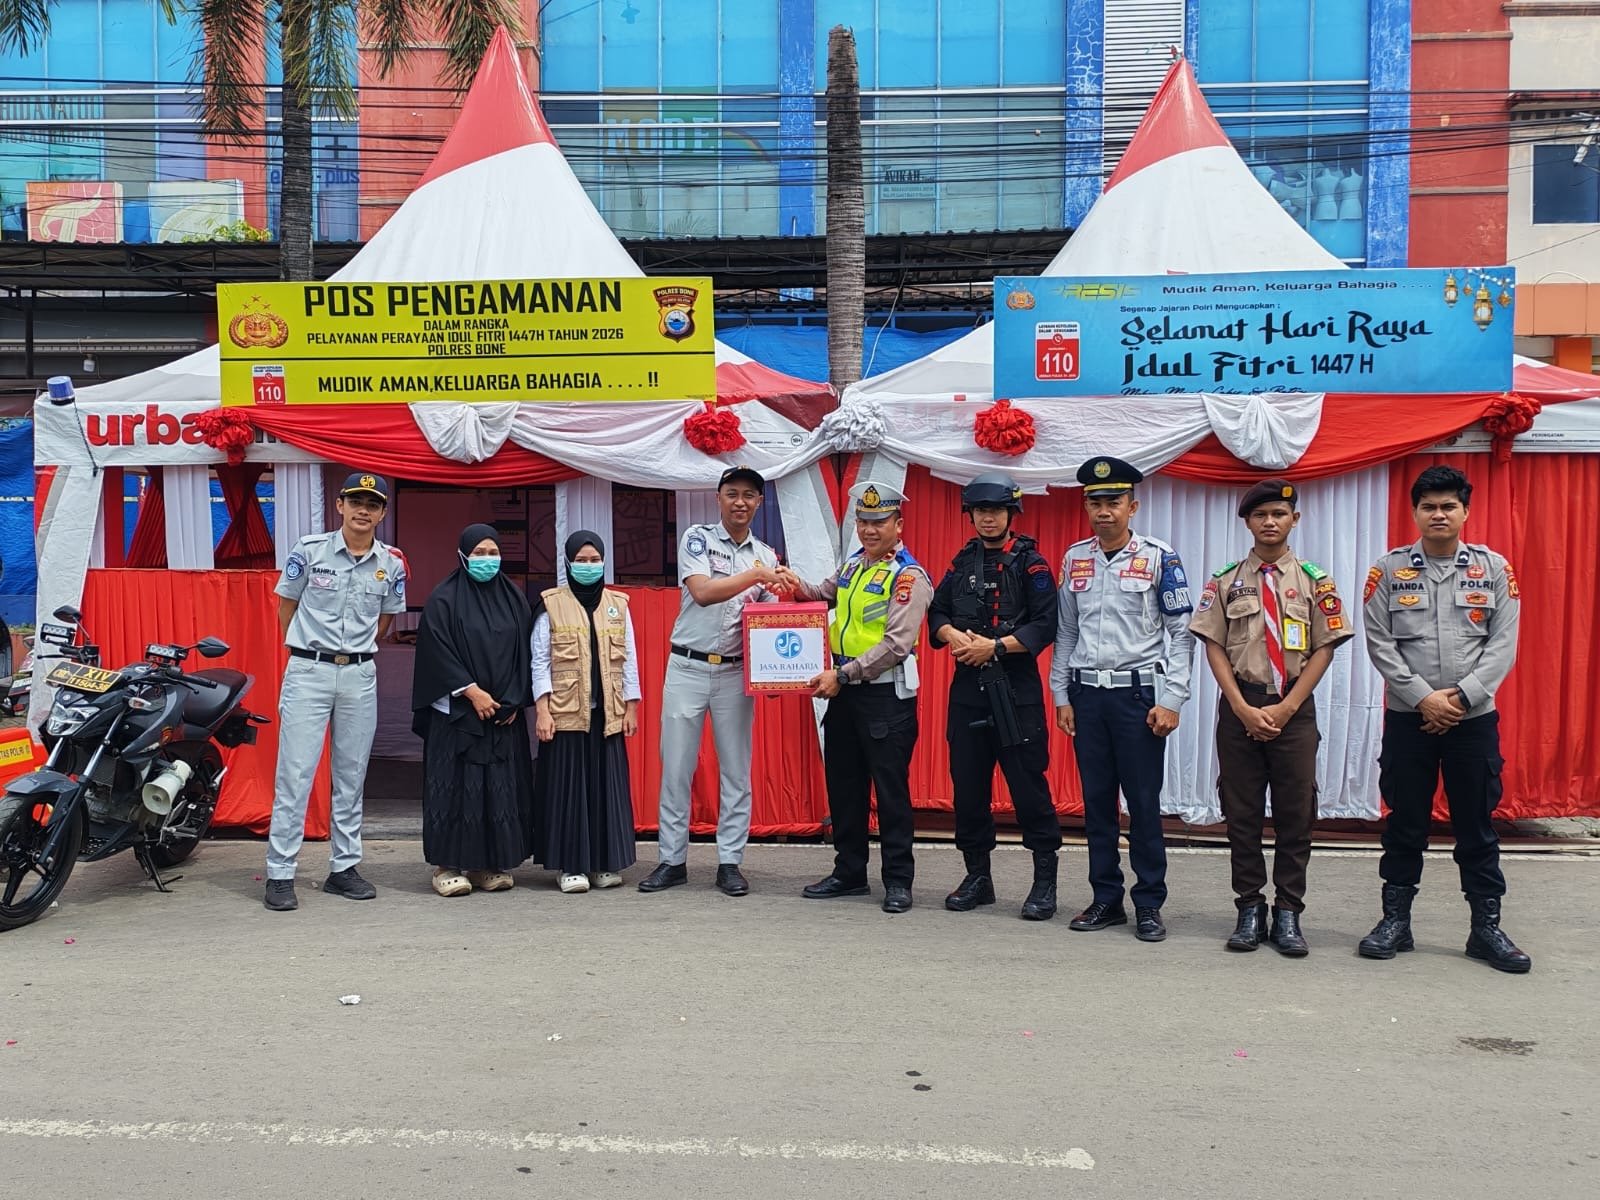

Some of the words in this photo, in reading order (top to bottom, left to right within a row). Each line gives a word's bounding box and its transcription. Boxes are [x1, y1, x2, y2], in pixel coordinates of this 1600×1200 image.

[1162, 285, 1207, 294] Mudik
[1212, 284, 1260, 293] Aman,
[1265, 282, 1332, 291] Keluarga
[1338, 281, 1397, 290] Bahagia
[304, 286, 374, 316] POS
[387, 281, 622, 316] PENGAMANAN
[1120, 305, 1156, 313] Segenap
[1159, 304, 1190, 312] Jajaran
[1193, 303, 1212, 311] Polri
[1215, 302, 1275, 311] Mengucapkan
[424, 319, 460, 331] DALAM
[464, 318, 509, 330] RANGKA
[1120, 315, 1248, 347] Selamat
[1258, 310, 1342, 345] Hari
[1347, 310, 1433, 348] Raya
[307, 332, 377, 344] PELAYANAN
[382, 331, 444, 343] PERAYAAN
[447, 331, 473, 343] IDUL
[477, 330, 505, 342] FITRI
[509, 330, 545, 341] 1447H
[549, 329, 588, 340] TAHUN
[592, 328, 624, 340] 2026
[427, 344, 472, 356] POLRES
[475, 343, 506, 355] BONE
[1042, 352, 1073, 373] 110
[1208, 351, 1305, 382] Fitri
[1310, 353, 1354, 374] 1447
[1359, 353, 1373, 374] H
[318, 376, 373, 392] MUDIK
[526, 372, 602, 389] BAHAGIA
[258, 386, 281, 400] 110
[87, 404, 205, 446] urba
[1392, 582, 1424, 592] NANDA
[1460, 580, 1494, 590] POLRI
[84, 667, 113, 681] XIV
[760, 663, 778, 672] JASA
[780, 663, 819, 672] RAHARJA
